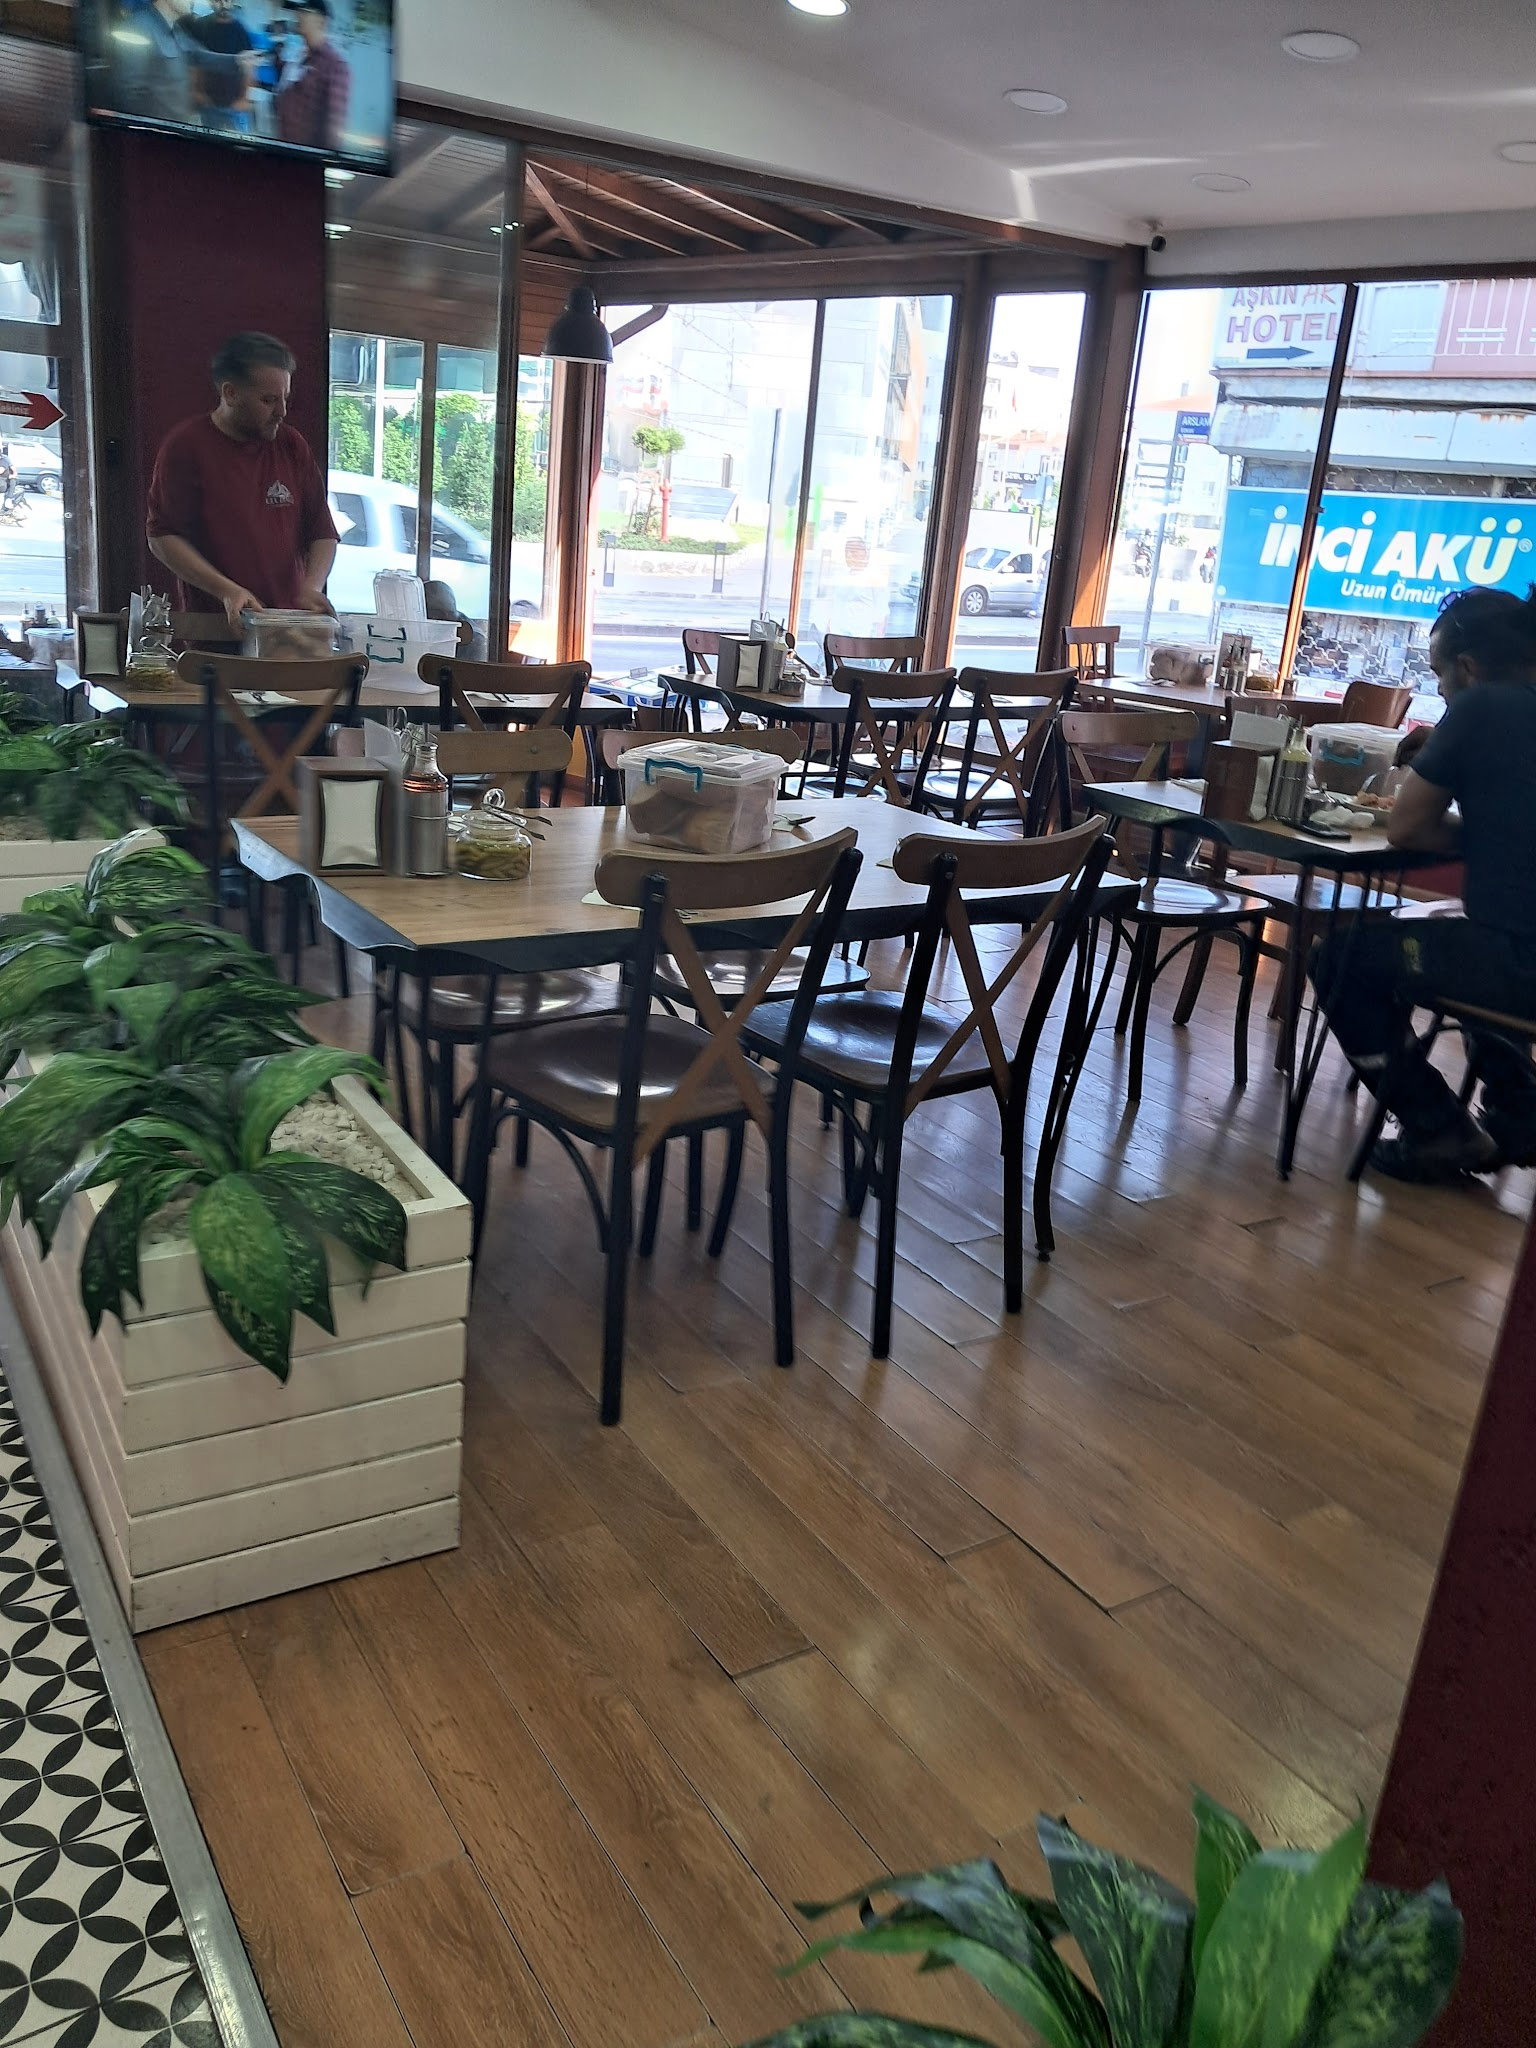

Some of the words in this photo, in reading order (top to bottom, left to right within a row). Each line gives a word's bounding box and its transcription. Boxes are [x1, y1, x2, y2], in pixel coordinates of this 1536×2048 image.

[1232, 285, 1297, 312] AŞKIN
[1302, 284, 1346, 306] AK
[1226, 312, 1339, 343] HOTEL
[1259, 505, 1376, 574] İNCİ
[1340, 578, 1387, 600] Uzun
[1390, 579, 1462, 605] Ömür
